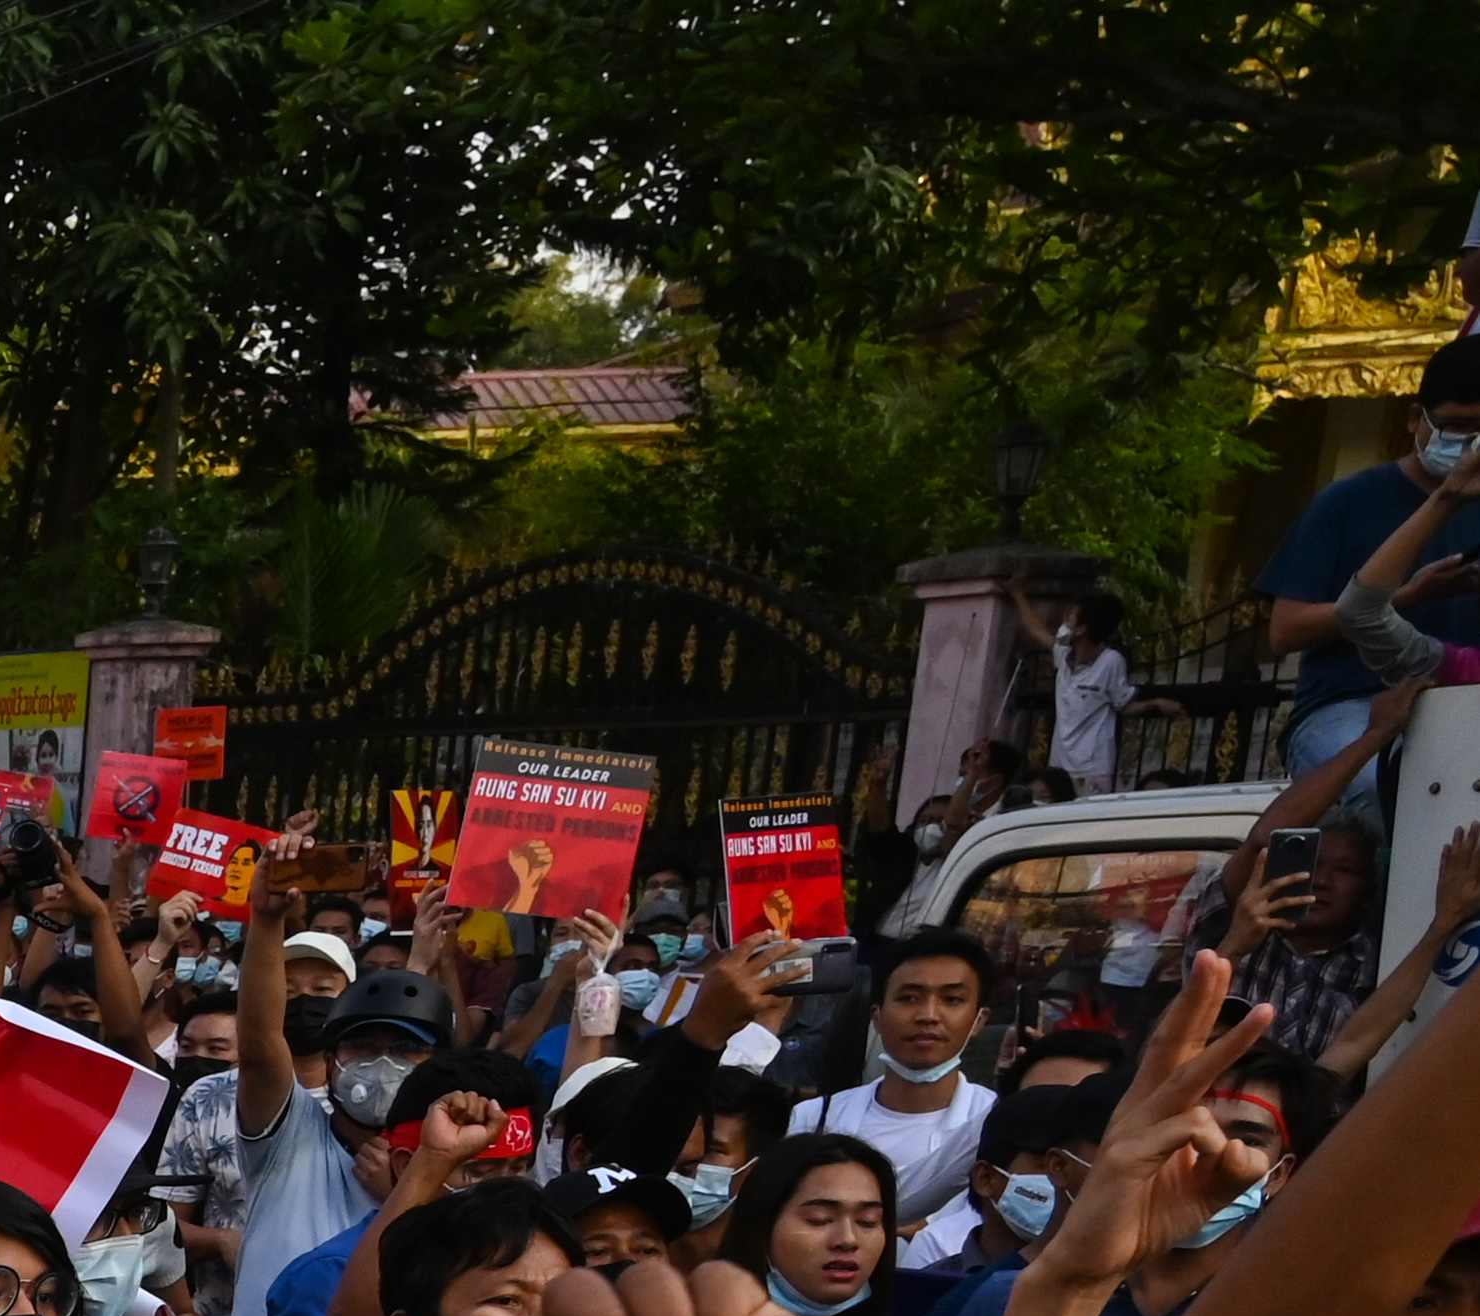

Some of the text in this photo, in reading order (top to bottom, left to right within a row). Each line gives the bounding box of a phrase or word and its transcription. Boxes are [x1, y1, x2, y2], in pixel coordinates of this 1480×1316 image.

[484, 740, 653, 771] Release Immediately
[517, 761, 611, 783] OUR LEADER
[474, 777, 643, 816] AUNG SAN SU KYI AND
[749, 811, 810, 829] OUR LEADER
[165, 822, 230, 862] FREE
[726, 837, 756, 858] AUNG
[758, 834, 778, 855] SAN
[779, 833, 793, 853] SU
[794, 831, 813, 852] KYI
